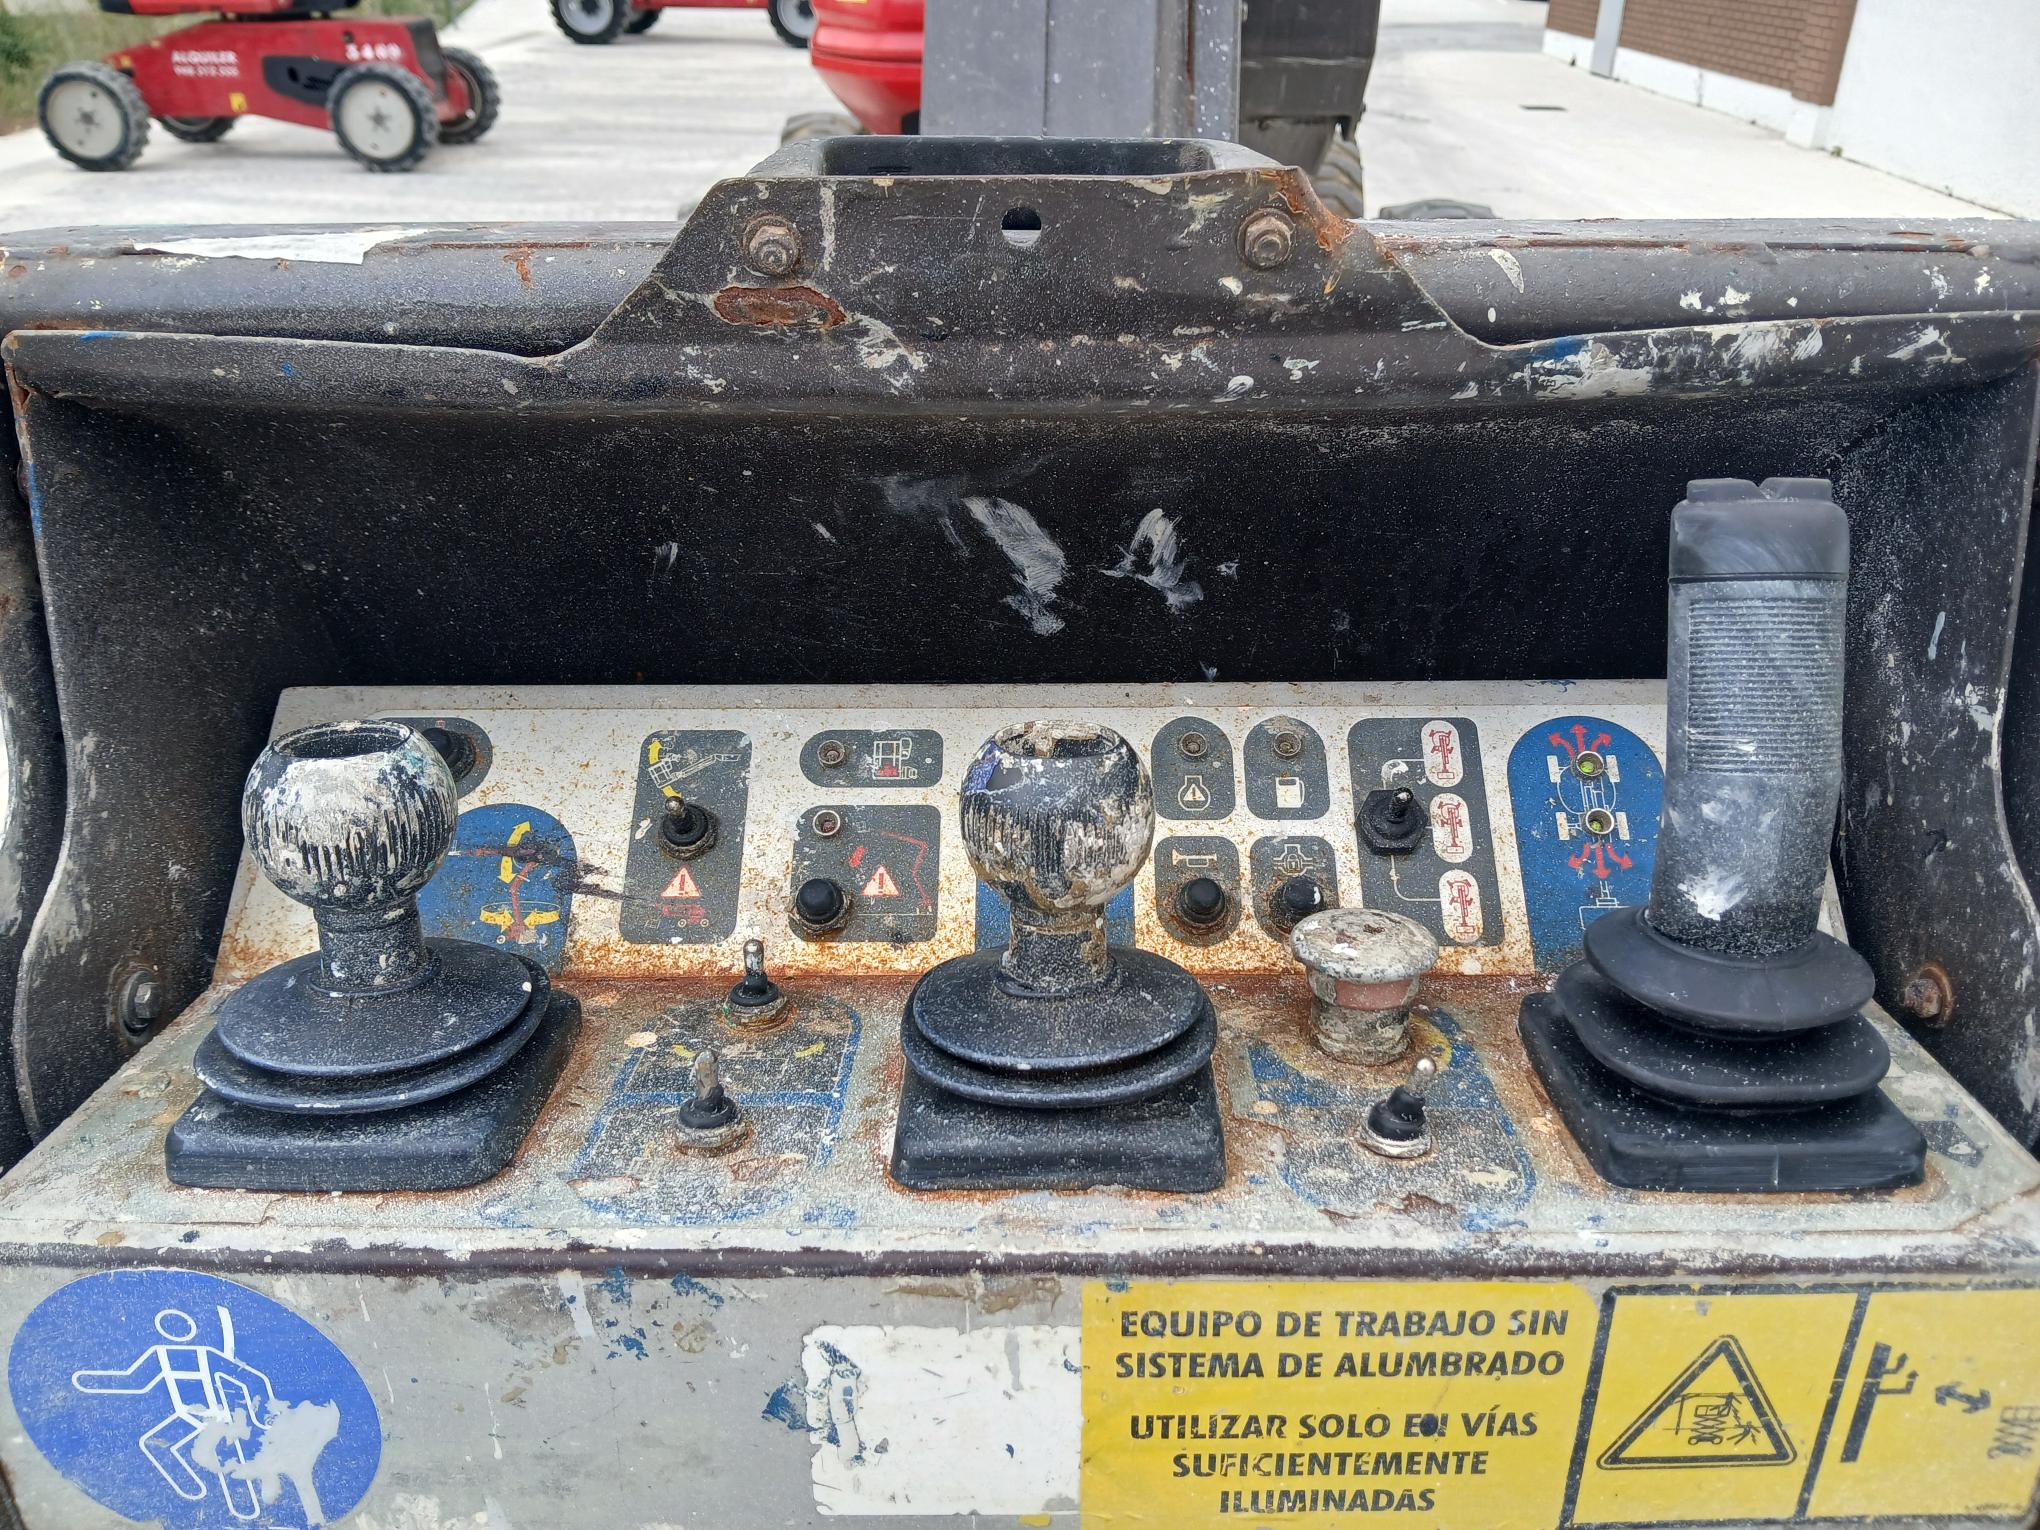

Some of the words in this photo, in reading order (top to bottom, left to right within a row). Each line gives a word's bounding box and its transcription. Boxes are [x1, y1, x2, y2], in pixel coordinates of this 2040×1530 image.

[1121, 1310, 1262, 1338] EQUIPO
[1276, 1311, 1322, 1337] DE
[1335, 1310, 1496, 1337] TRABAJO
[1507, 1309, 1569, 1336] SIN
[1115, 1352, 1264, 1378] SISTEMA
[1277, 1352, 1323, 1378] DE
[1333, 1351, 1565, 1377] ALUMBRADO
[1130, 1414, 1287, 1440] UTILIZAR
[1299, 1413, 1391, 1438] SOLO
[1461, 1404, 1538, 1437] VÍAS
[1172, 1451, 1489, 1477] SUFICIENTEMENTE
[1219, 1488, 1436, 1514] ILUMINADAS
